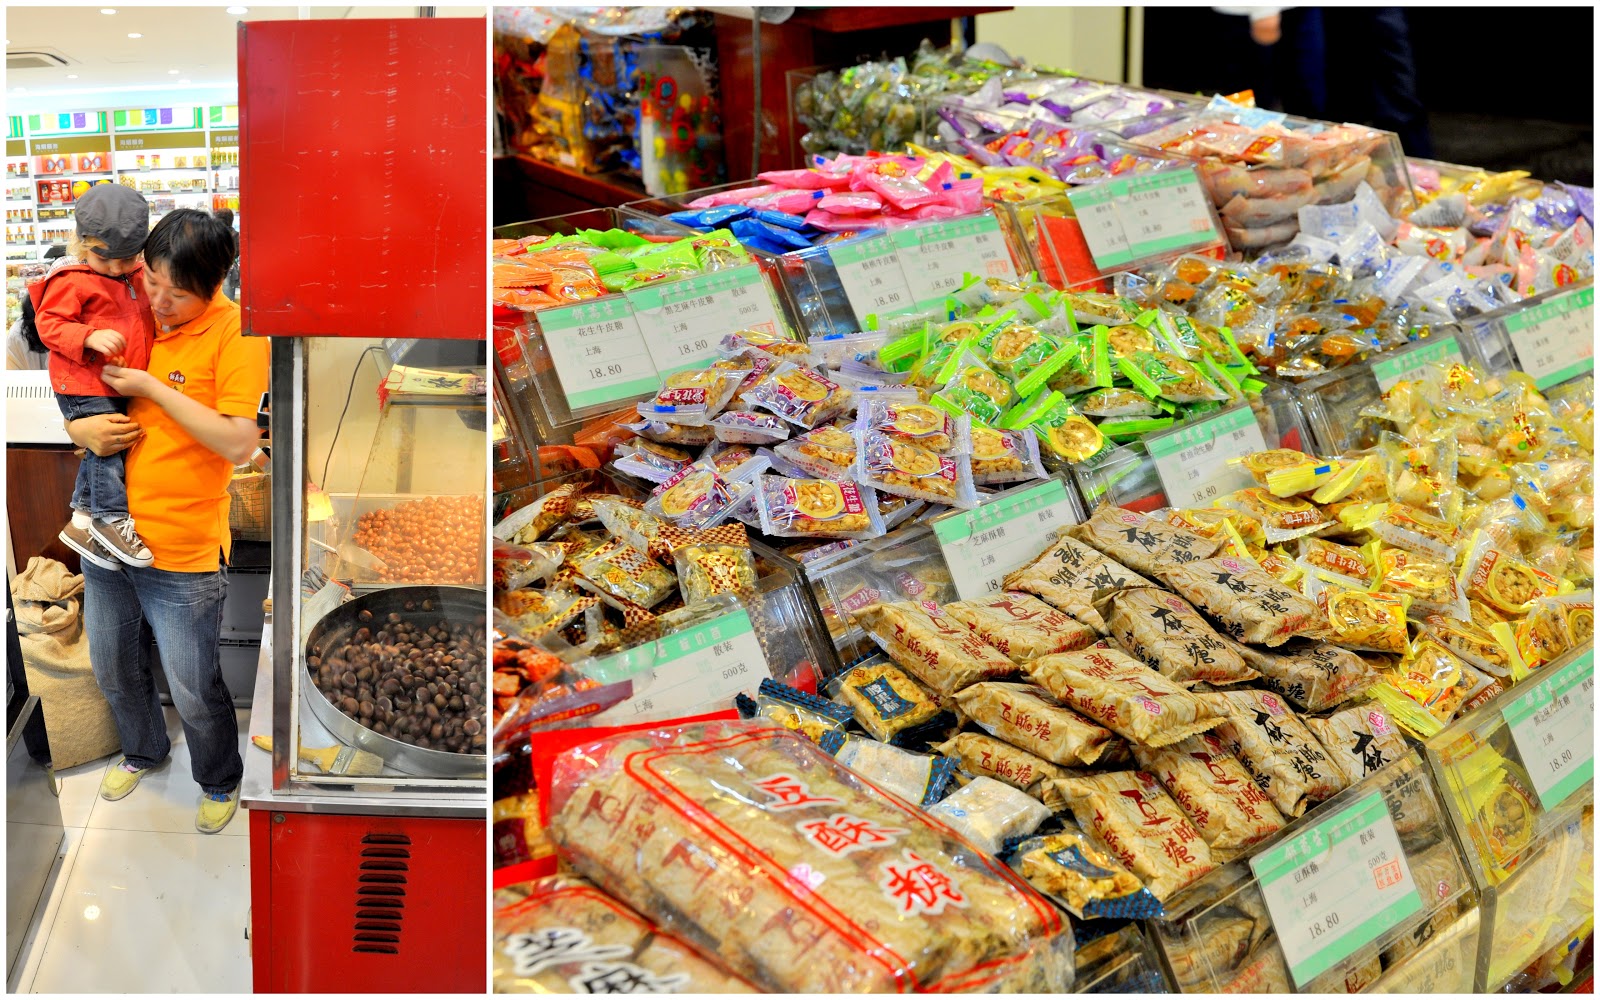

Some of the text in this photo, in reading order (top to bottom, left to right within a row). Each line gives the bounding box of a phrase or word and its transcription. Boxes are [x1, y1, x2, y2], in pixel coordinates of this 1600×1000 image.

[869, 277, 883, 288] 上海
[931, 277, 956, 291] 18.80
[731, 287, 747, 298] 散装
[873, 292, 900, 308] 18.80
[664, 295, 715, 316] 黑芝麻牛皮糖
[738, 304, 760, 316] 500克
[578, 320, 624, 337] 花生牛皮糖
[673, 322, 689, 334] 上海
[585, 345, 602, 357] 上海
[678, 339, 708, 356] 18.80
[589, 363, 622, 380] 18.80
[1187, 469, 1200, 481] 上海
[1192, 485, 1217, 503] 18.80
[1037, 508, 1054, 523] 散装
[971, 526, 1006, 547] 芝麻酥糖
[980, 554, 997, 568] 上海
[985, 575, 1005, 593] 18.
[713, 640, 734, 657] 散装
[722, 663, 749, 680] 500克
[632, 699, 654, 716] 上海
[1000, 701, 1052, 742] 豆酥糖
[1542, 732, 1555, 747] 上海
[980, 750, 1034, 785] 豆酥糖
[1549, 749, 1573, 773] 18.80
[1359, 829, 1376, 846] 散装
[1367, 851, 1389, 869] 500克
[1294, 864, 1320, 885] 豆酥糖
[1301, 891, 1318, 908] 上海
[1308, 911, 1340, 941] 18.80
